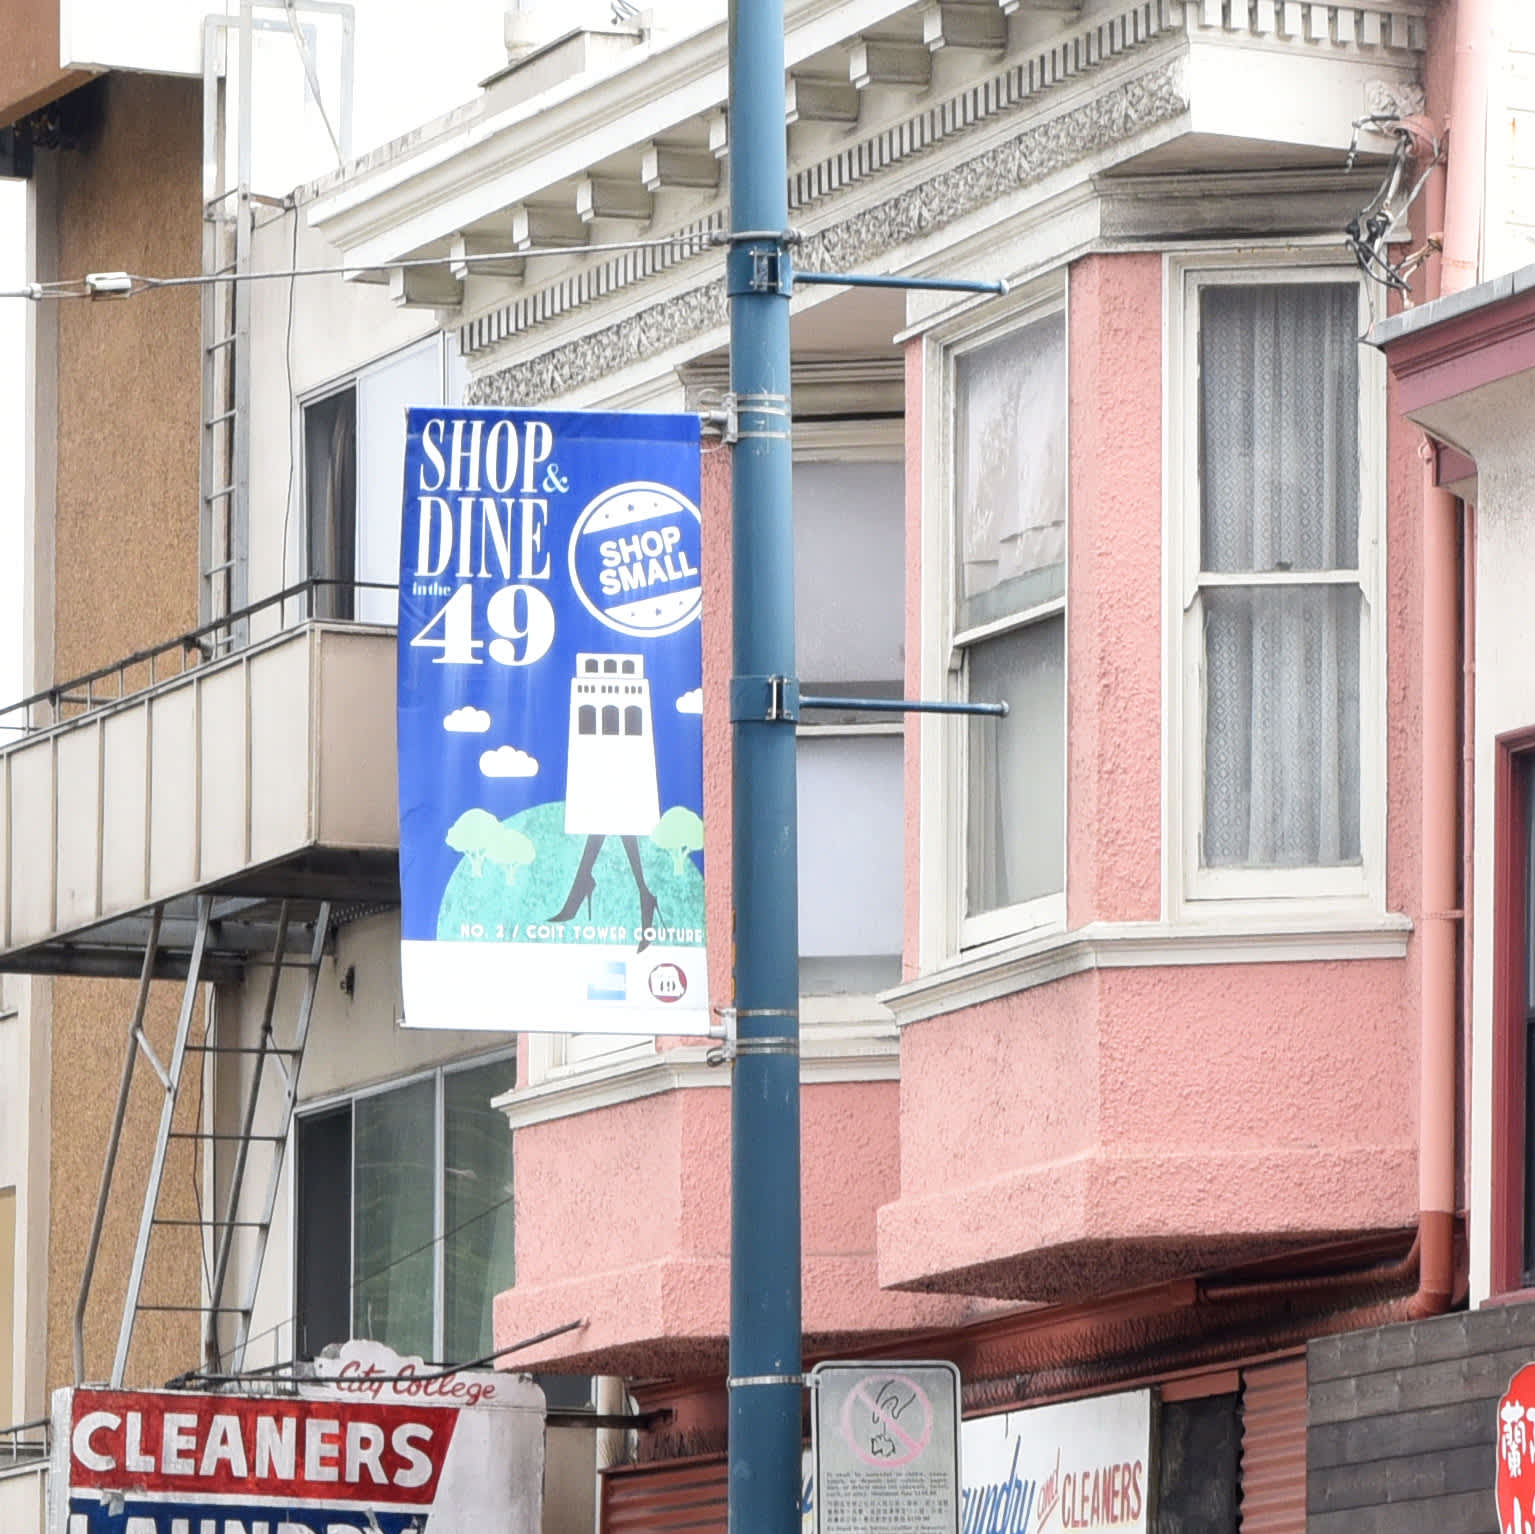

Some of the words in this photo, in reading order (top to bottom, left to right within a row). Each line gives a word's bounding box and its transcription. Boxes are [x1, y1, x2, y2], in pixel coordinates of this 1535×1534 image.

[419, 419, 554, 493] SHOP
[542, 463, 569, 493] &
[414, 496, 551, 580] DINE
[599, 526, 681, 567] SHOP
[599, 551, 698, 595] SMALL
[410, 583, 555, 666] 49
[460, 923, 489, 939] NO.
[526, 925, 565, 940] COIT
[573, 926, 627, 941] TOWER
[633, 927, 704, 943] COUTURE
[336, 1360, 387, 1400] City
[391, 1363, 496, 1406] College
[71, 1411, 434, 1488] CLEANERS
[1061, 1460, 1143, 1529] CLEANERS
